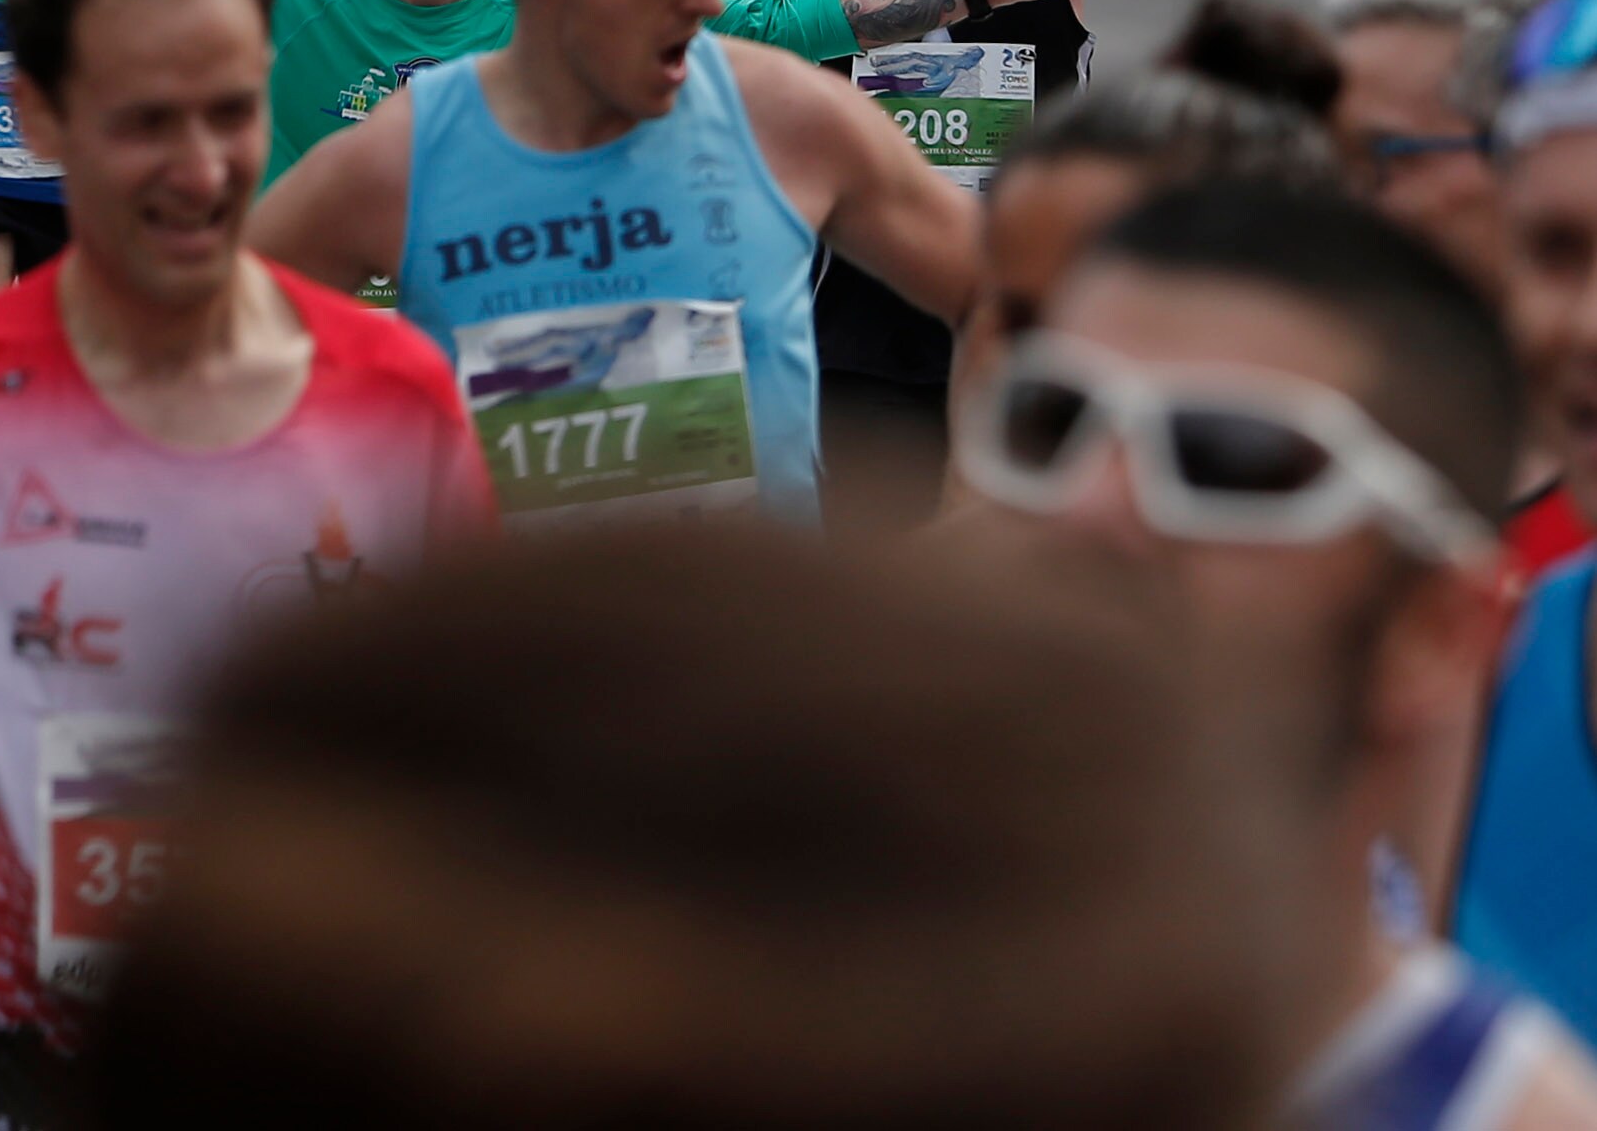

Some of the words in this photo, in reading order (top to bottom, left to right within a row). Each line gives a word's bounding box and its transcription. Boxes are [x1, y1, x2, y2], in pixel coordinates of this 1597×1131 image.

[881, 108, 970, 147] 208
[437, 197, 672, 283] nerja
[477, 273, 647, 318] ATLETISMO
[497, 402, 648, 478] 1777
[77, 835, 167, 906] 35
